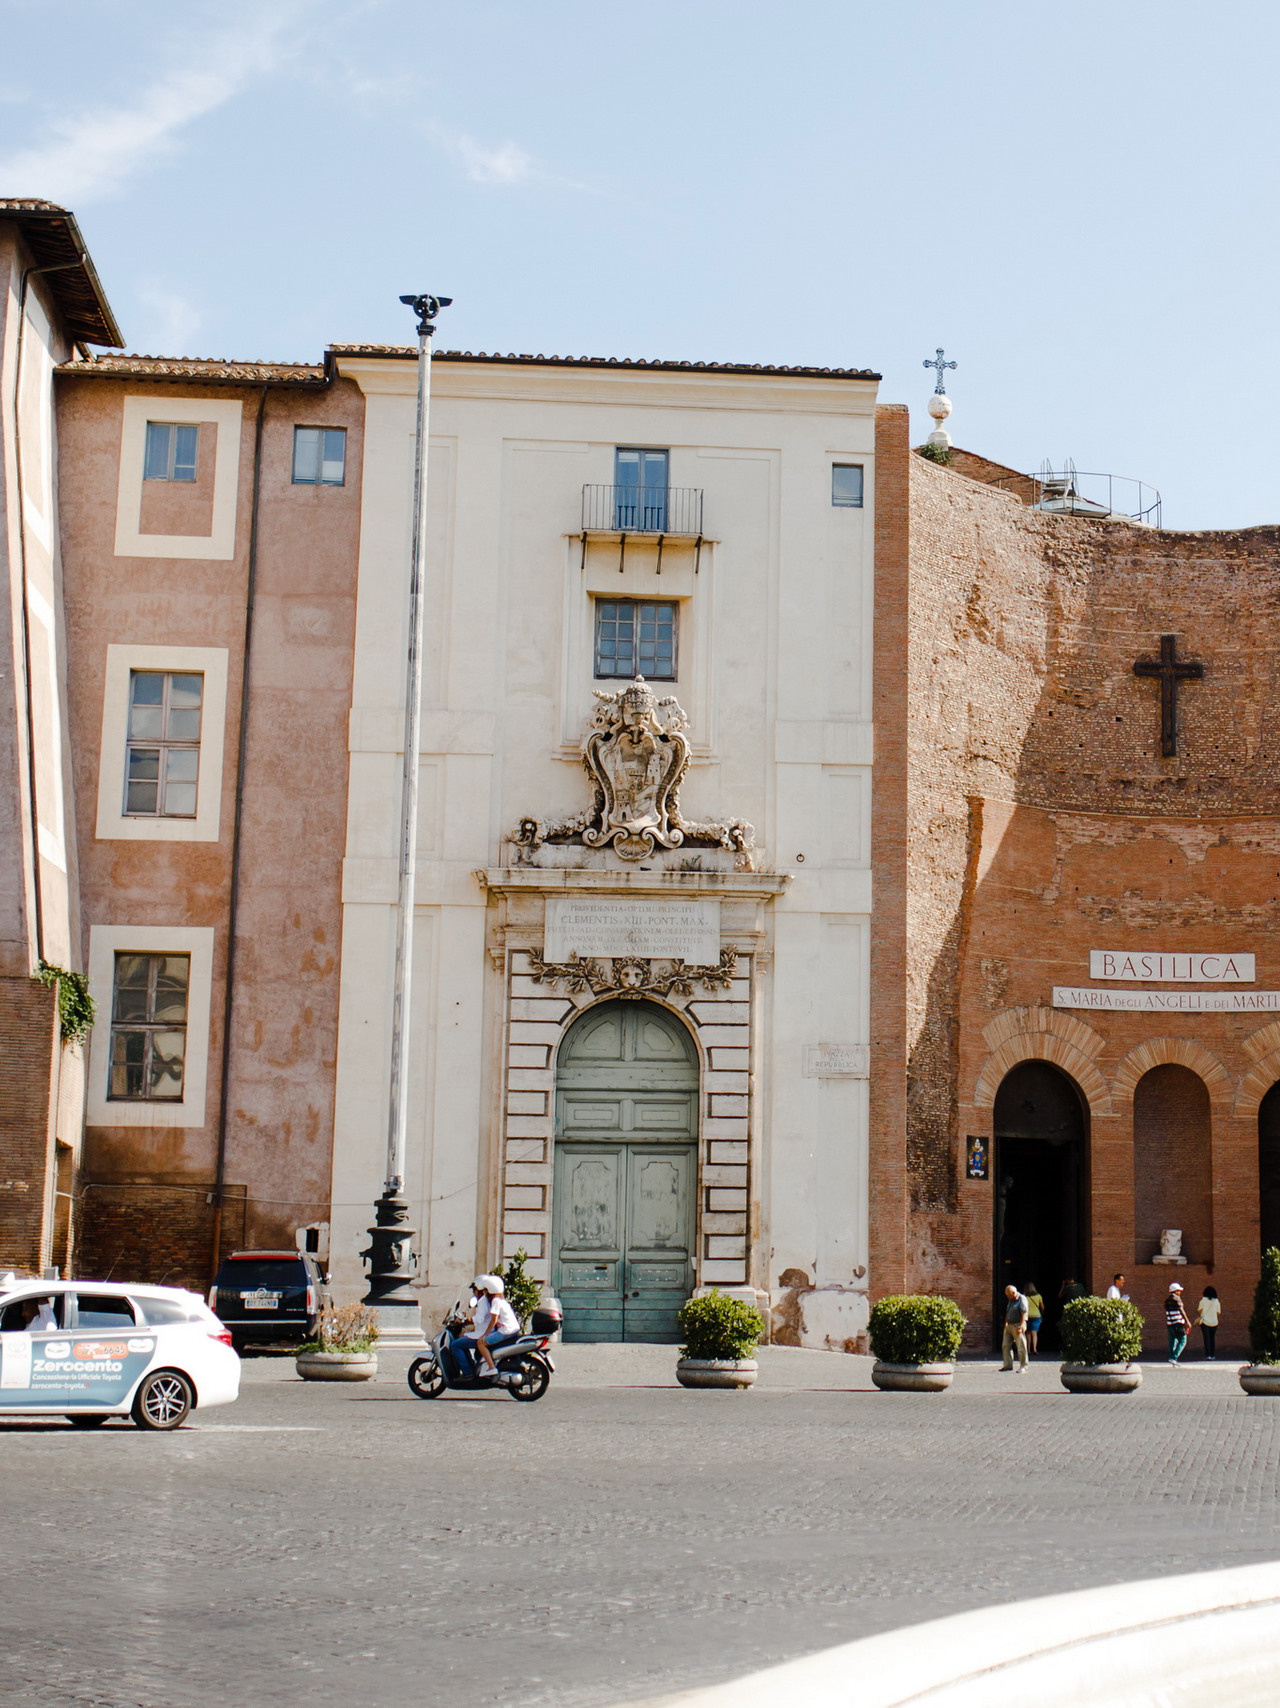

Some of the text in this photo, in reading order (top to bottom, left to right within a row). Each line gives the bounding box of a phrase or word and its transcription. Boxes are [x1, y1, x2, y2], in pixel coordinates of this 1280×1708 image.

[560, 915, 618, 924] CLEMENTIS
[624, 915, 642, 925] XIII
[1103, 954, 1240, 979] BASILICA
[1057, 990, 1066, 1004] S.
[1070, 991, 1112, 1007] MARIA
[1114, 998, 1141, 1008] DEGLI
[1144, 994, 1201, 1009] ANGELI
[1205, 999, 1211, 1009] E
[1214, 1000, 1229, 1009] DEI
[33, 1359, 123, 1372] Zerocento
[102, 1374, 122, 1382] Toyota
